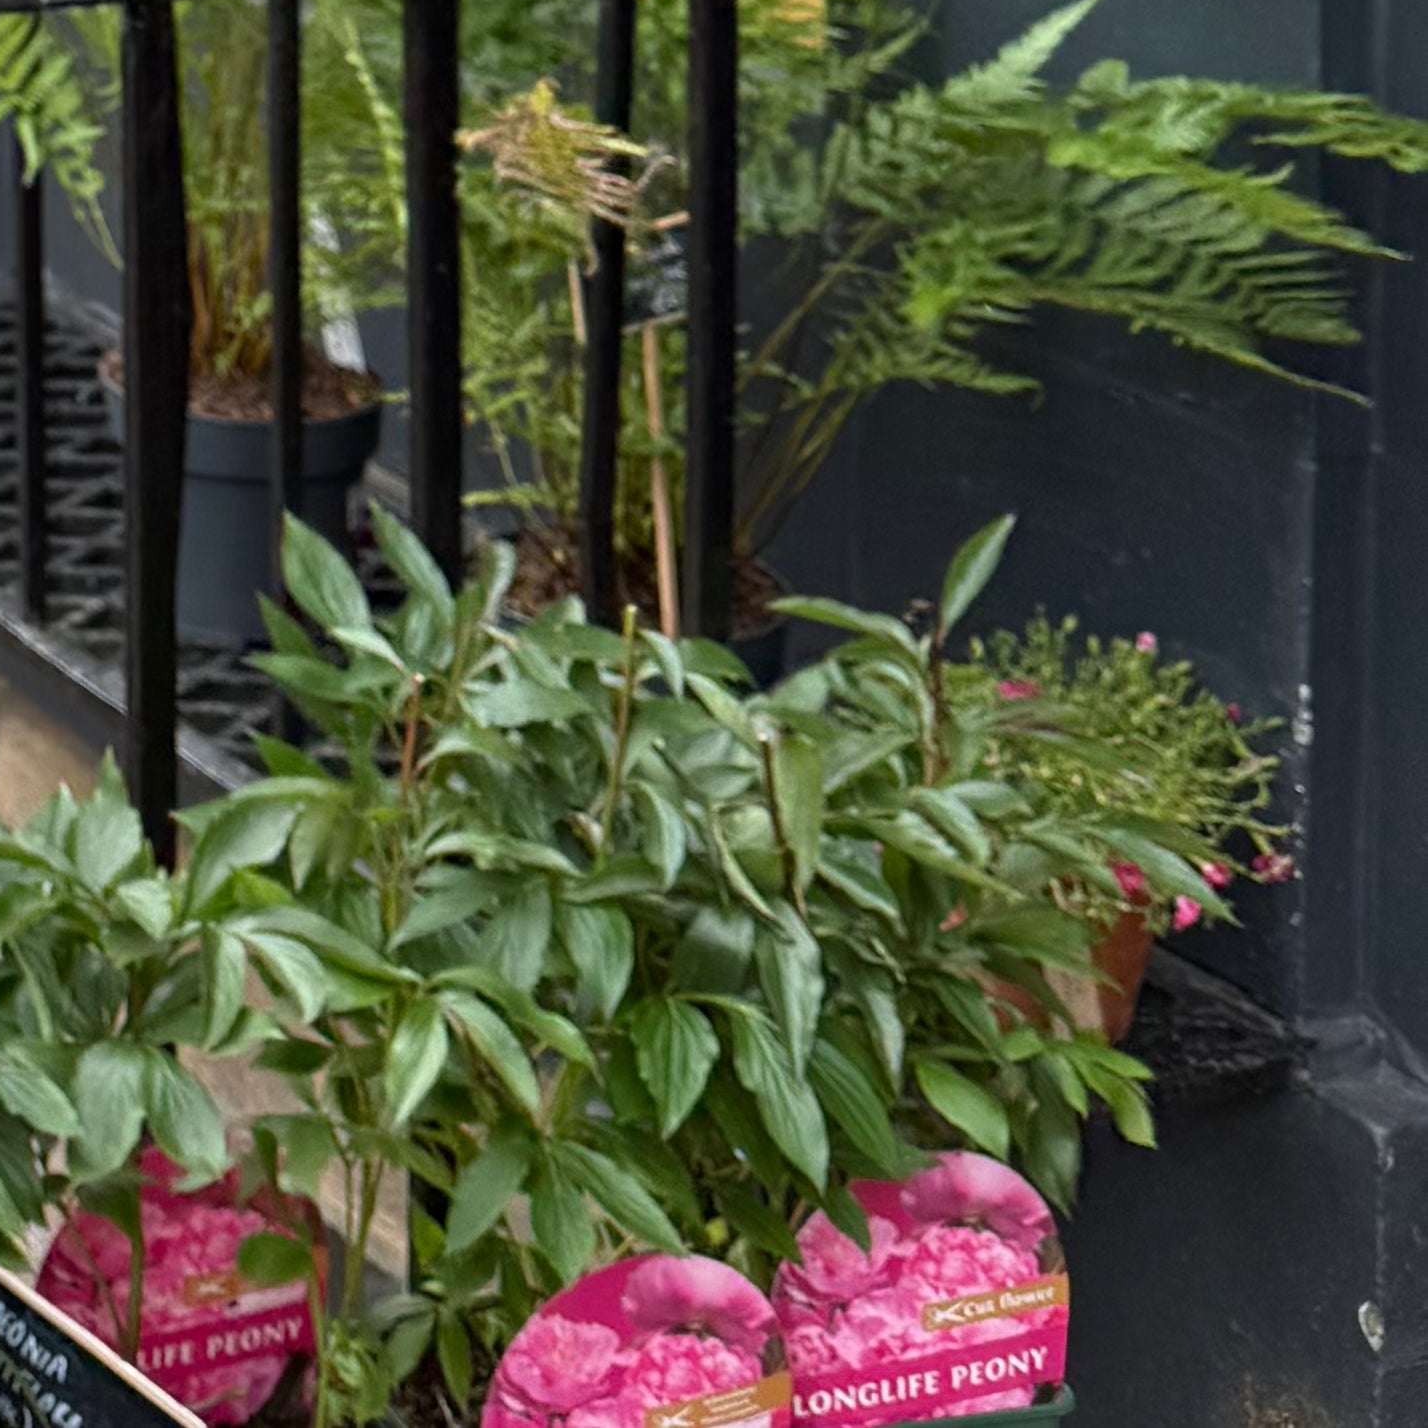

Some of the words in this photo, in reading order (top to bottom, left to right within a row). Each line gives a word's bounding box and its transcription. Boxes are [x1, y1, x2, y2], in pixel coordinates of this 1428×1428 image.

[206, 1315, 304, 1360] PEONY
[794, 1370, 940, 1419] LONGLIFE
[950, 1345, 1048, 1390] PEONY
